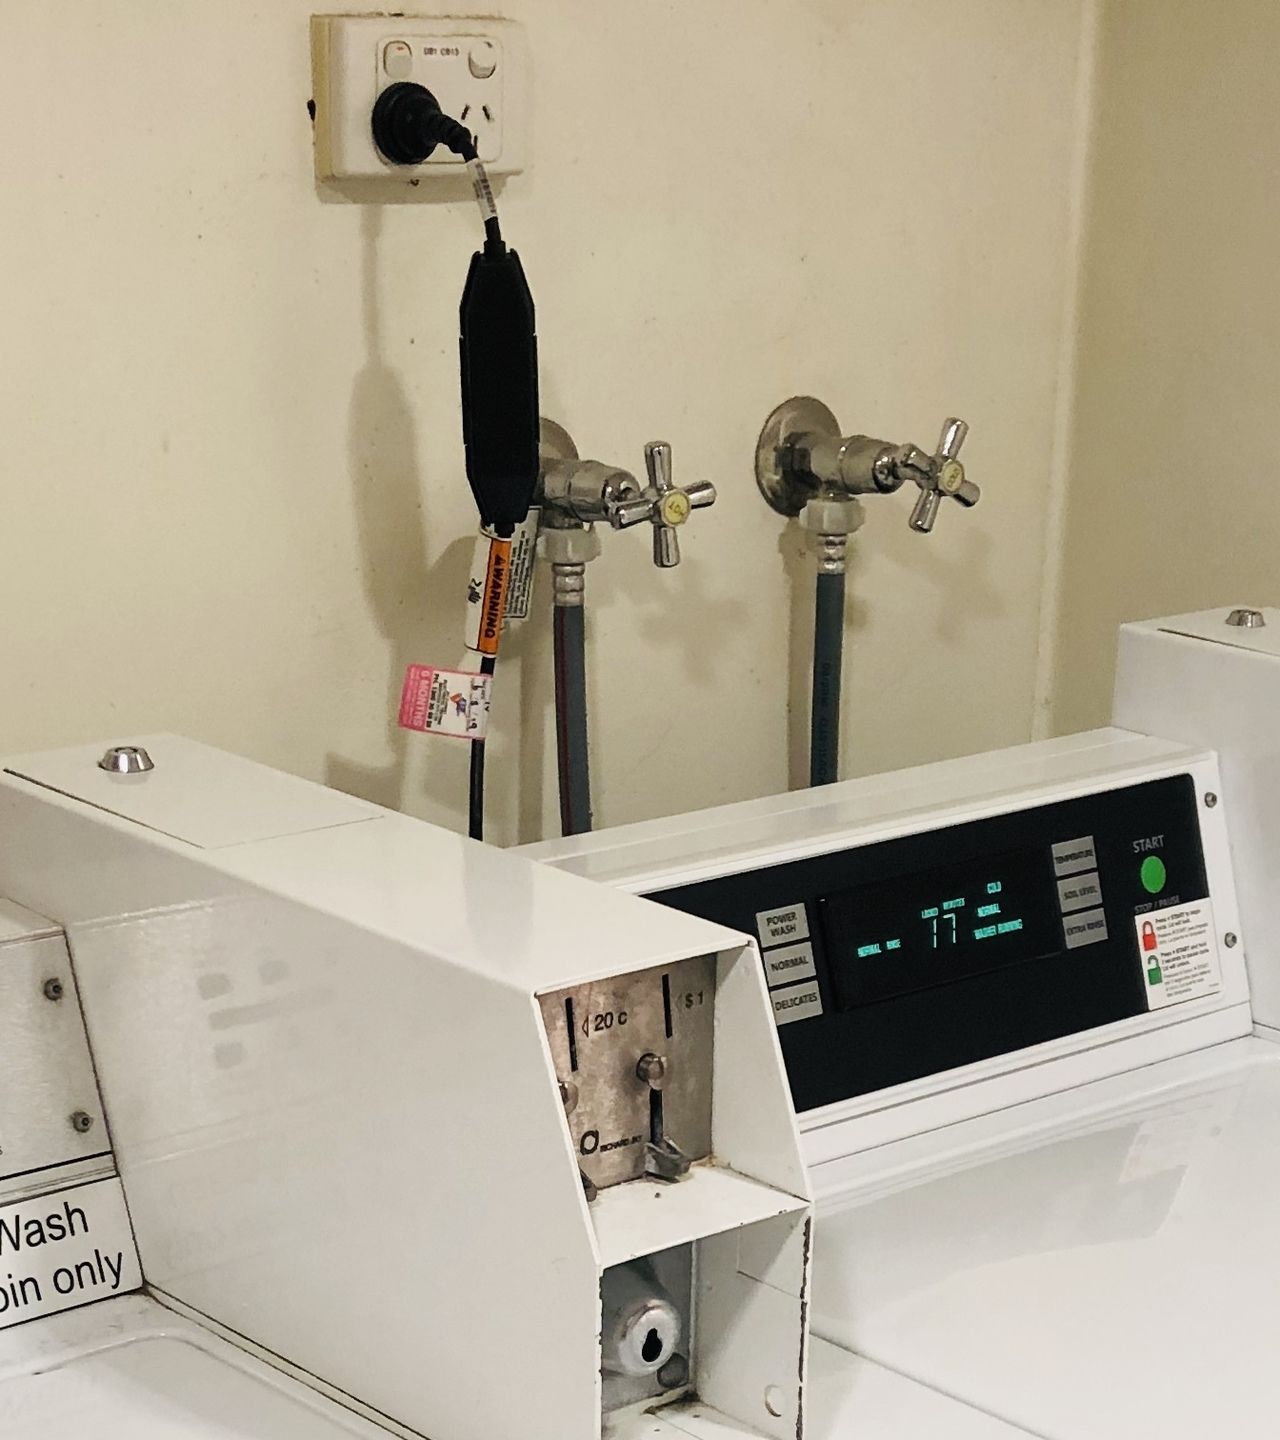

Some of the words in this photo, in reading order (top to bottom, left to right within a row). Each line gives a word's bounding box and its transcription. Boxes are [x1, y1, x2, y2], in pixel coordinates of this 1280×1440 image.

[485, 569, 507, 639] WARNING
[1133, 835, 1165, 853] START
[766, 912, 797, 926] POWER
[770, 923, 796, 937] WASH
[771, 955, 808, 972] NORMAL
[775, 992, 818, 1011] DELICATES
[53, 1249, 123, 1296] only
